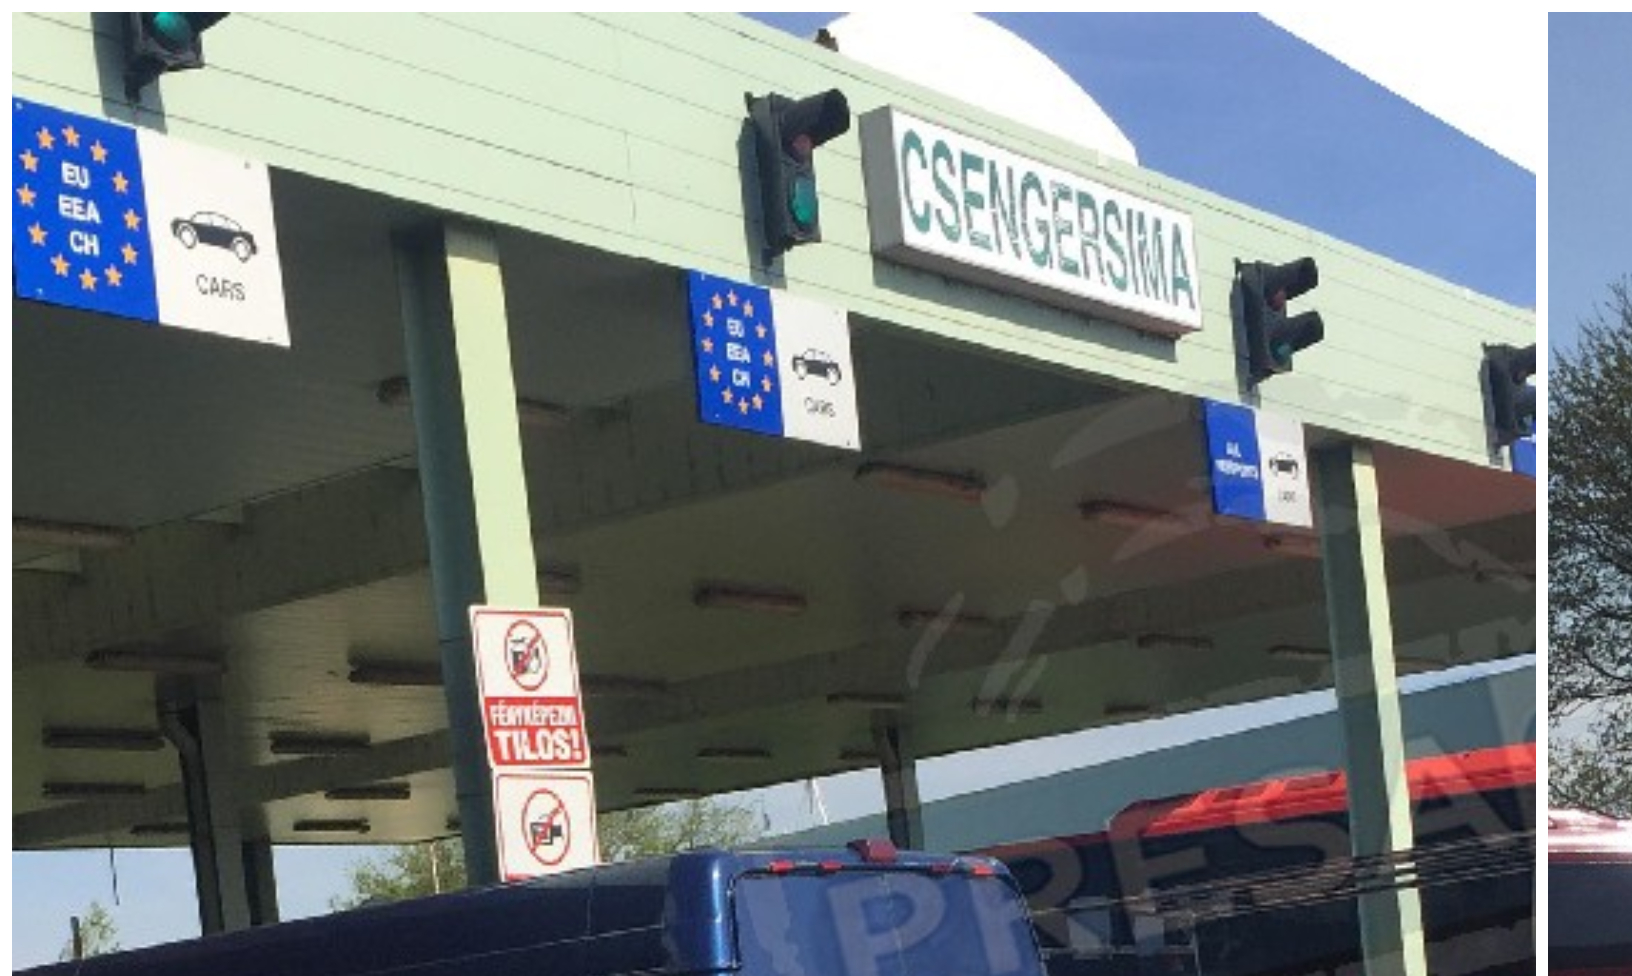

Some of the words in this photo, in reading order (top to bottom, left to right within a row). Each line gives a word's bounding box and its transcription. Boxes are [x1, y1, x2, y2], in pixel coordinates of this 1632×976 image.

[61, 161, 91, 190] EU
[58, 194, 102, 224] EEA
[901, 129, 1197, 310] CSENGERSIMA
[69, 230, 100, 256] CH
[195, 273, 246, 302] CARS
[726, 317, 745, 338] EU
[726, 341, 751, 364] EEA
[732, 367, 751, 389] CH
[804, 396, 836, 418] CARS
[493, 726, 583, 761] TILOS!
